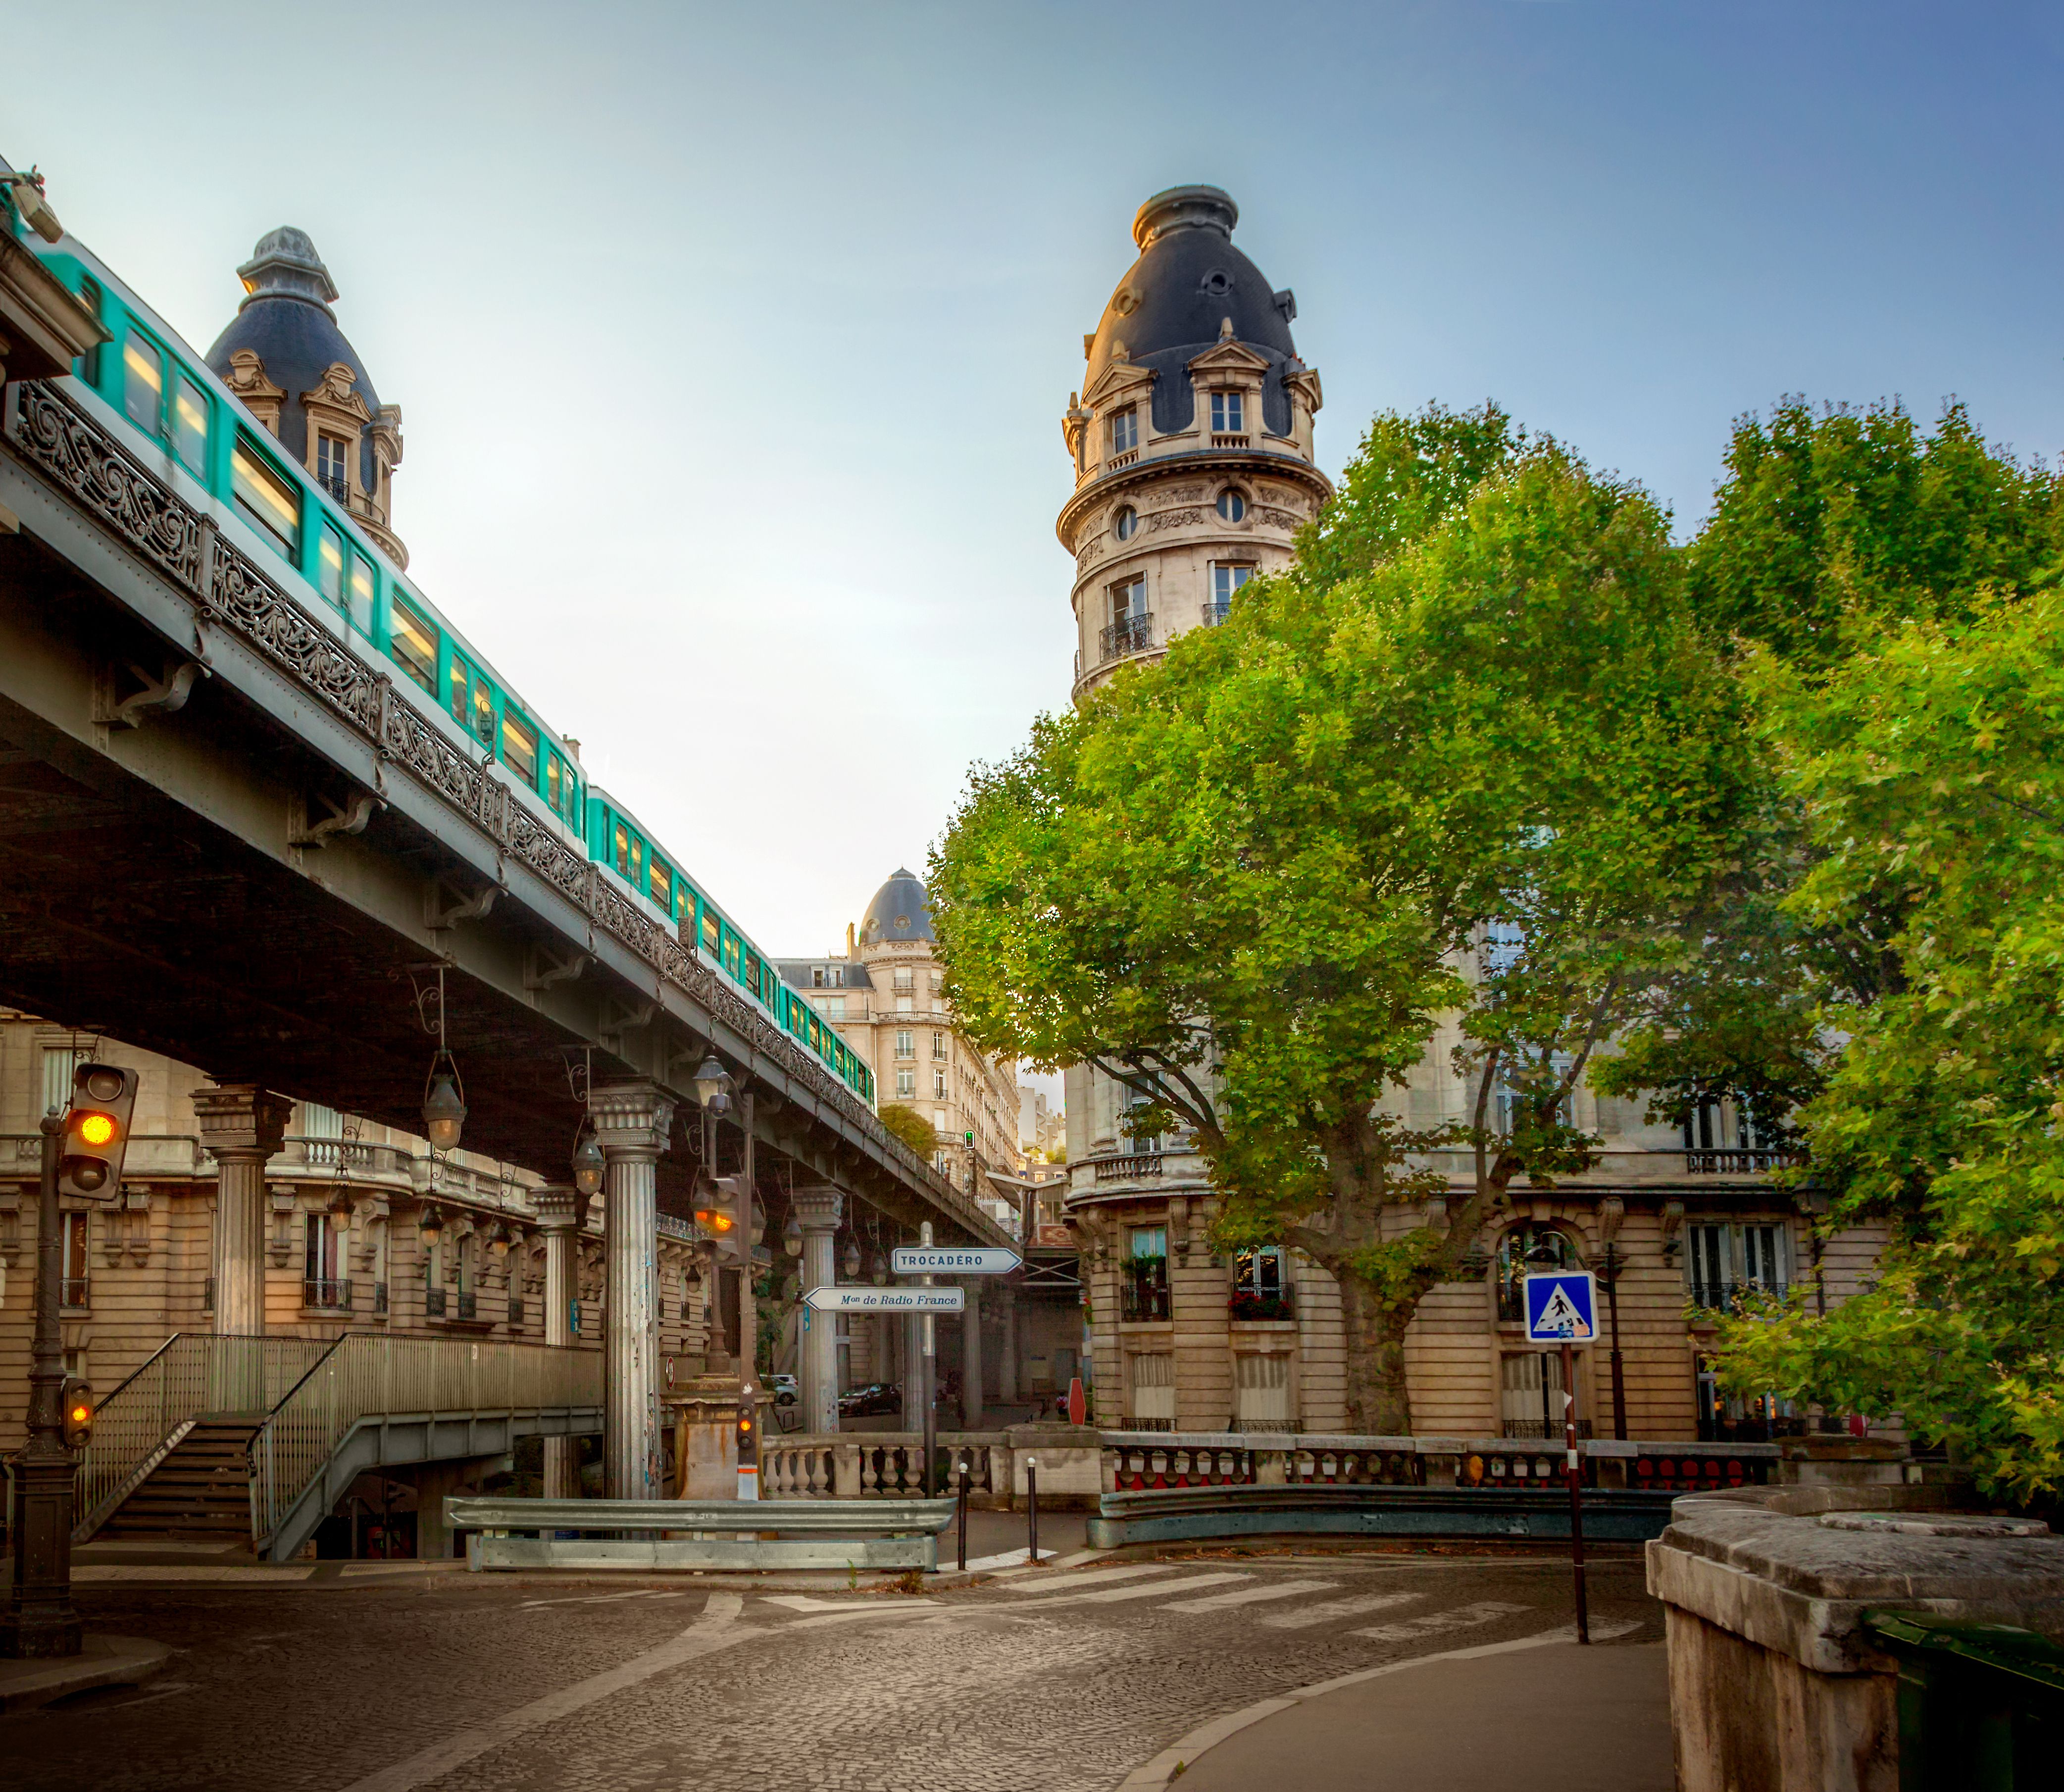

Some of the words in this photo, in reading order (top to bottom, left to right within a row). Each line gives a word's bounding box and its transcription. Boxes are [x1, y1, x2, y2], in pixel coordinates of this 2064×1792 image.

[901, 1254, 982, 1265] TROCADÉRO
[863, 1295, 877, 1304] de
[880, 1295, 912, 1304] Radio
[917, 1295, 957, 1304] France
